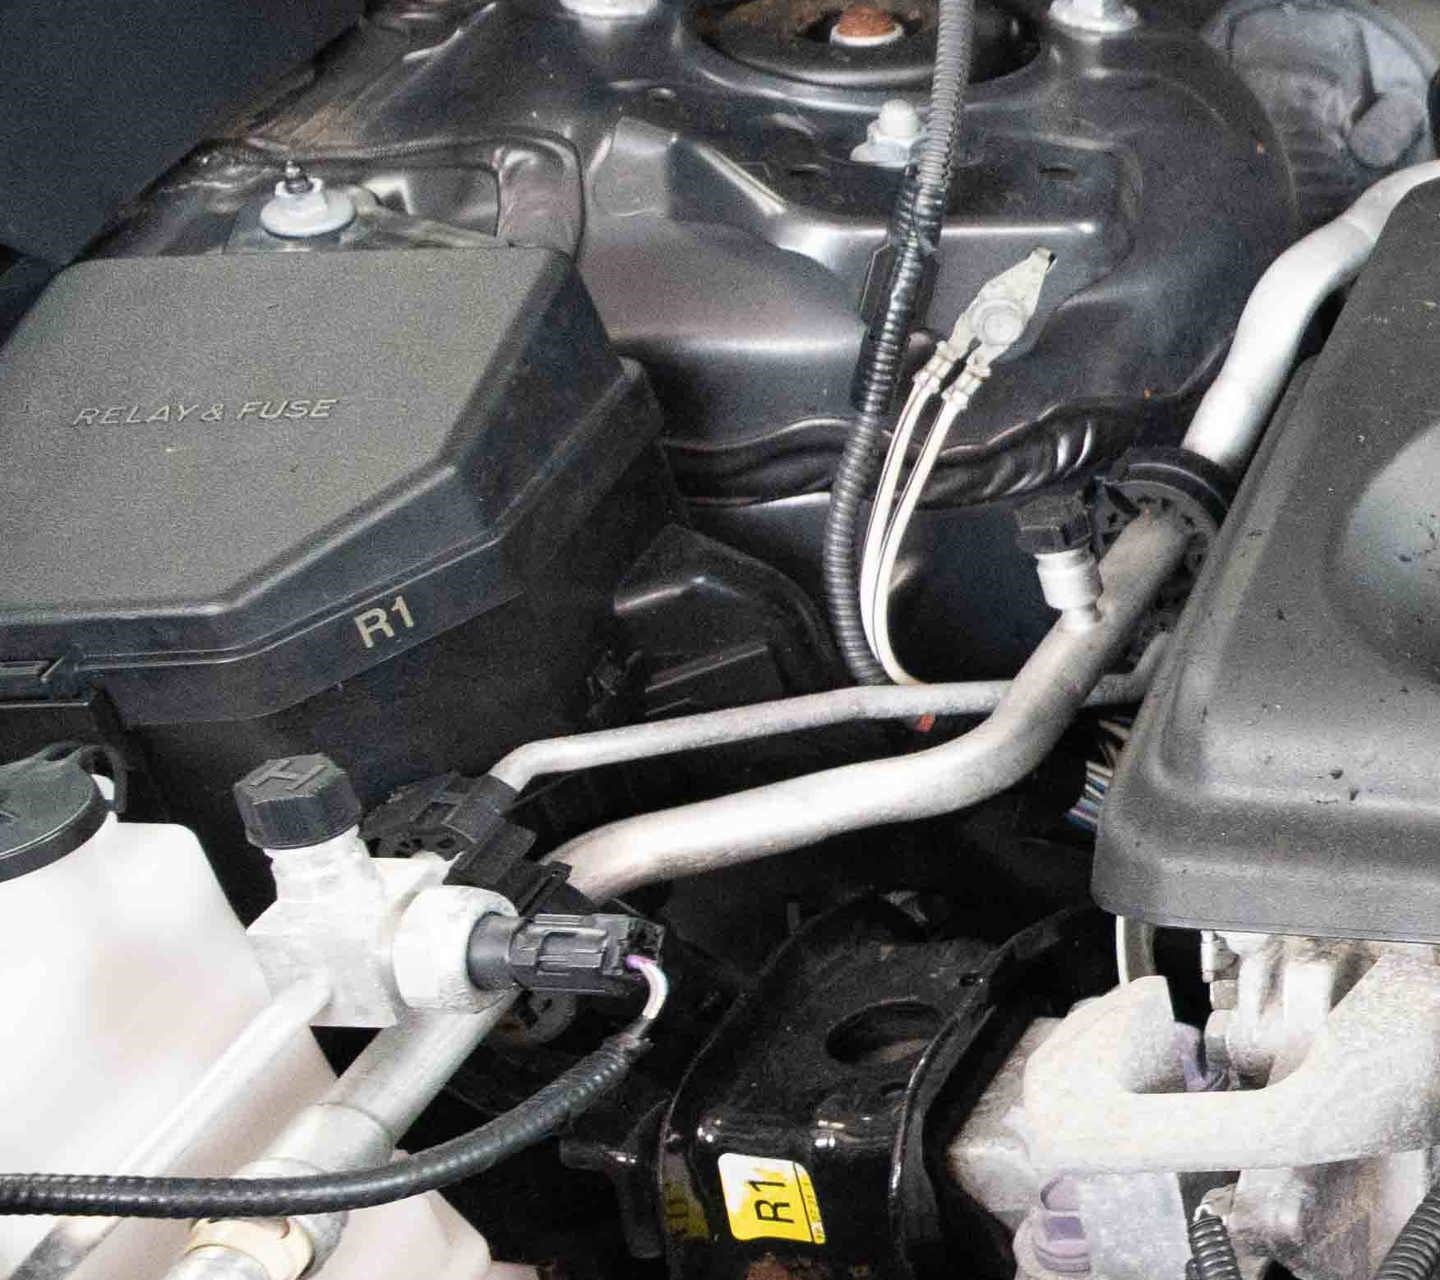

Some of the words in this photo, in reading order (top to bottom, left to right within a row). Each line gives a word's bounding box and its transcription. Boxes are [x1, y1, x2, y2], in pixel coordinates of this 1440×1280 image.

[73, 402, 196, 426] RELAY
[200, 402, 227, 422] &
[234, 397, 342, 421] FUSE
[352, 595, 416, 649] R1
[748, 1179, 794, 1224] R1
